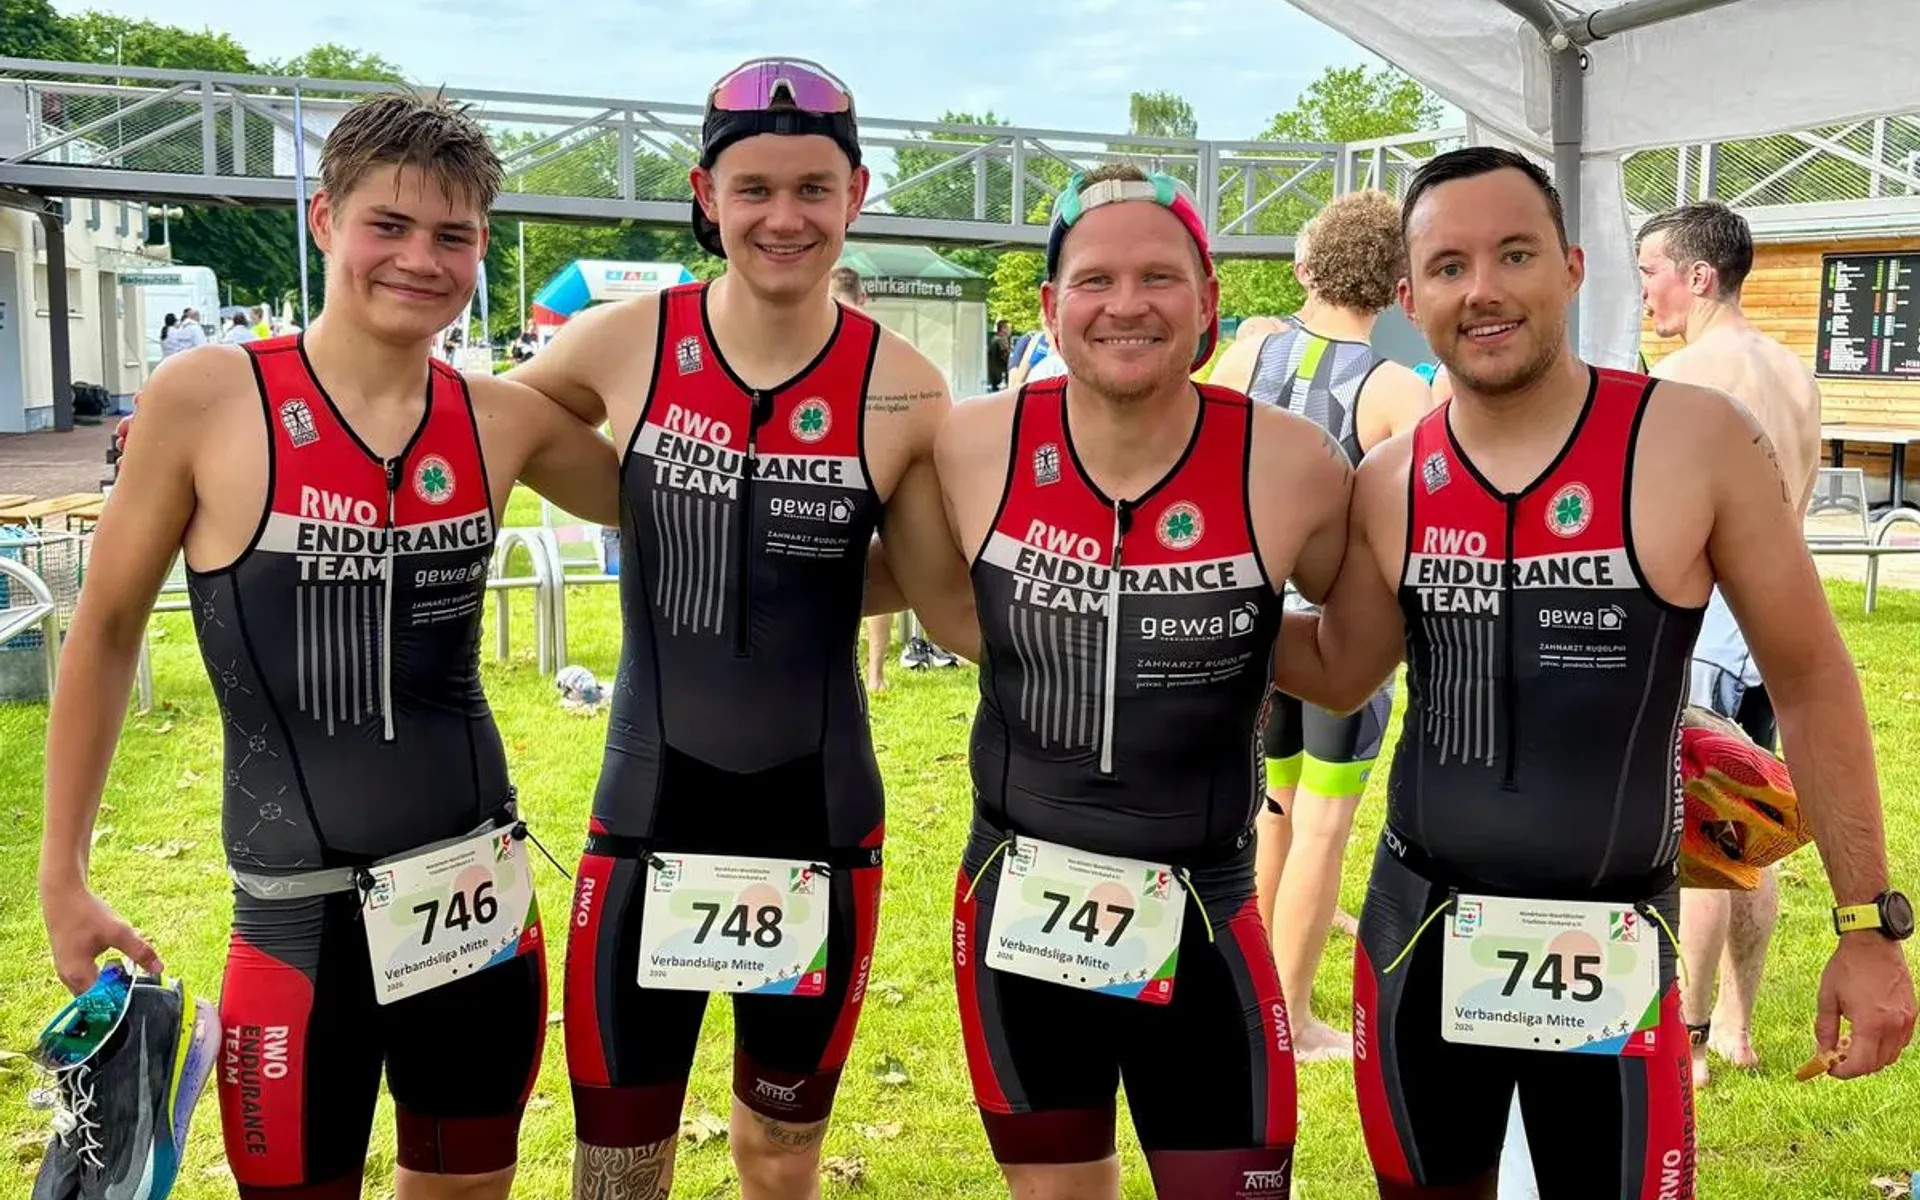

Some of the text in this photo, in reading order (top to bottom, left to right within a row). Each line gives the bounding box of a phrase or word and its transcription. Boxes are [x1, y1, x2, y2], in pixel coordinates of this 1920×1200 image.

[663, 403, 732, 446] RWO
[653, 458, 738, 500] TEAM
[655, 432, 844, 484] ENDURANCE
[301, 485, 378, 526] RWO
[770, 497, 826, 517] gewa
[297, 516, 488, 555] ENDURANCE
[1024, 519, 1101, 562] RWO
[1423, 526, 1487, 557] RWO
[296, 555, 387, 581] TEAM
[415, 567, 468, 588] gewa
[1014, 547, 1238, 592] ENDURANCE
[1418, 555, 1614, 587] ENDURANCE
[1013, 574, 1110, 617] TEAM
[1416, 587, 1500, 616] TEAM
[1141, 616, 1223, 639] gewa
[1539, 609, 1594, 627] gewa
[1137, 659, 1201, 669] ZAHNARZT
[413, 880, 498, 946] 746
[577, 877, 596, 927] RWO
[1041, 890, 1135, 947] 747
[692, 902, 783, 948] 748
[956, 919, 967, 967] RWO
[384, 937, 489, 981] Verbandsliga Mitte
[651, 955, 765, 971] Verbandsliga Mitte
[1000, 936, 1110, 970] Verbandsliga Mitte
[852, 955, 869, 1004] RWO
[1497, 949, 1603, 1002] 745
[1272, 1003, 1290, 1052] RWO
[1356, 1002, 1367, 1061] RWO
[1454, 1022, 1474, 1032] 2026
[1455, 1006, 1585, 1028] Verbandsliga Mitte
[225, 1025, 241, 1085] TEAM
[263, 1025, 289, 1079] RWO
[241, 1025, 268, 1156] ENDURANCE
[755, 1078, 797, 1102] ATHO
[1244, 1171, 1284, 1190] ATHO
